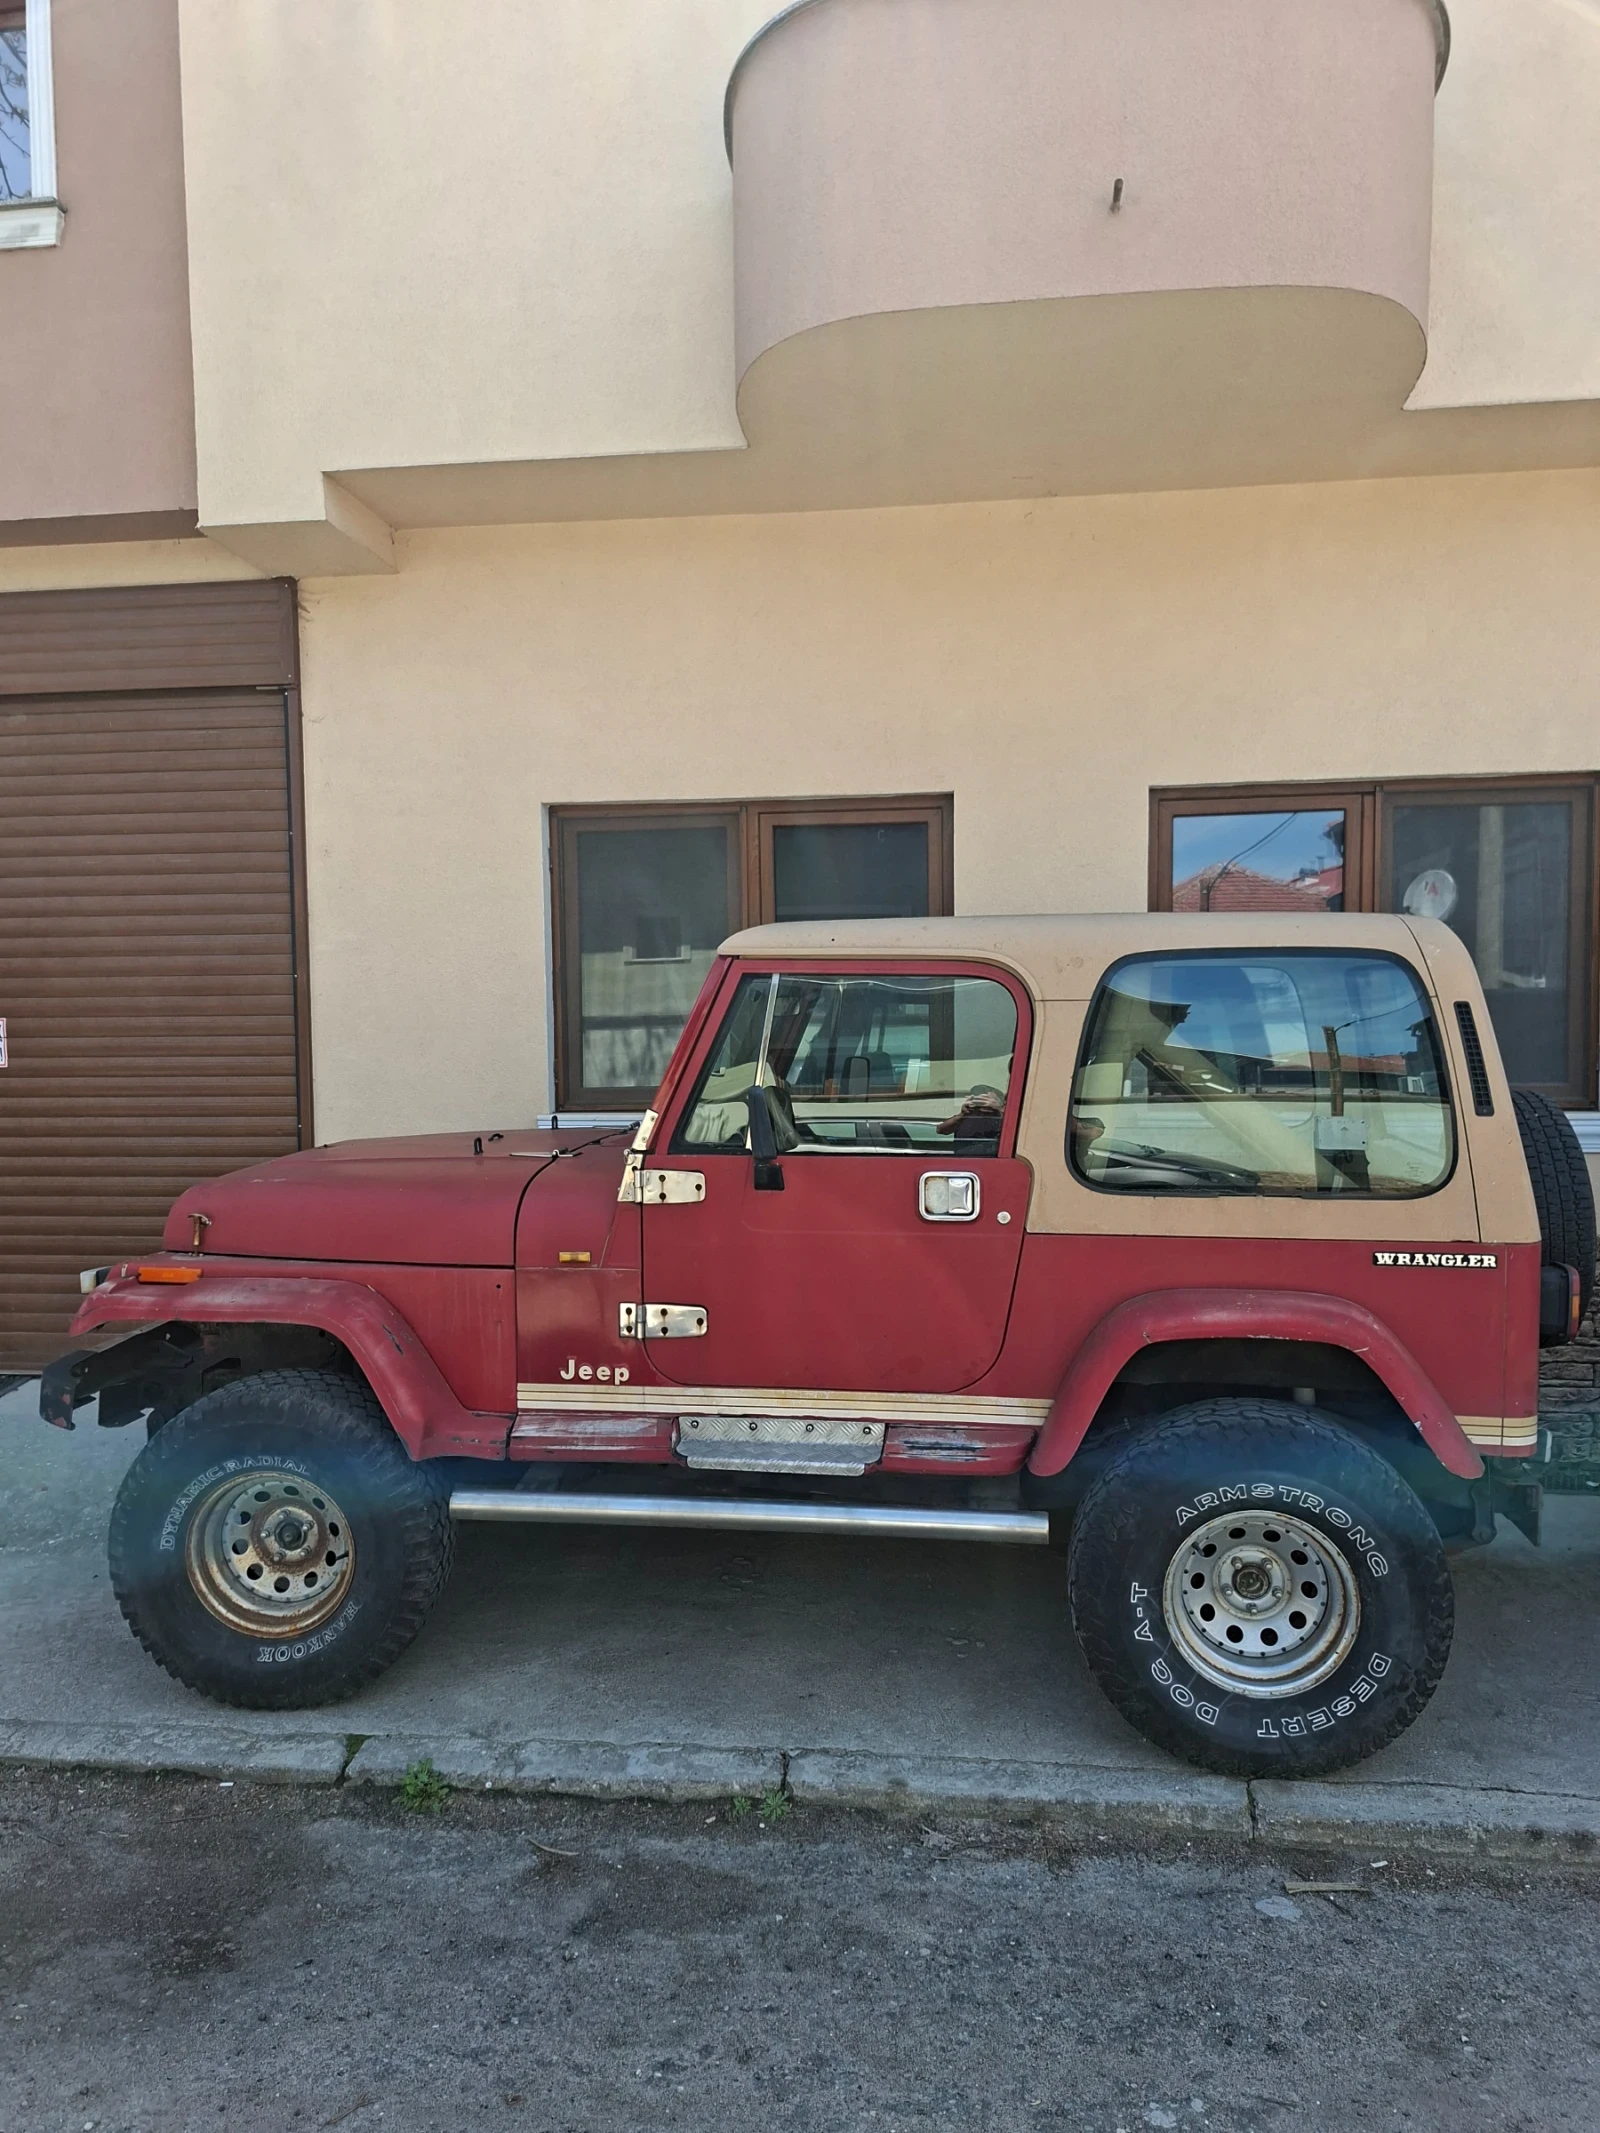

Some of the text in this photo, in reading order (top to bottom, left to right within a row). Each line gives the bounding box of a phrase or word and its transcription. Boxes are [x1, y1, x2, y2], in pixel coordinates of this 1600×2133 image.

[1374, 1252, 1497, 1268] WRANGLER
[560, 1358, 630, 1386] Jeep
[160, 1455, 310, 1551] DYNAMIC RADIAL
[1175, 1483, 1389, 1578] ARMSTRONG
[257, 1601, 360, 1663] HANKOOK
[1130, 1582, 1392, 1738] DESERT DOG A-T
